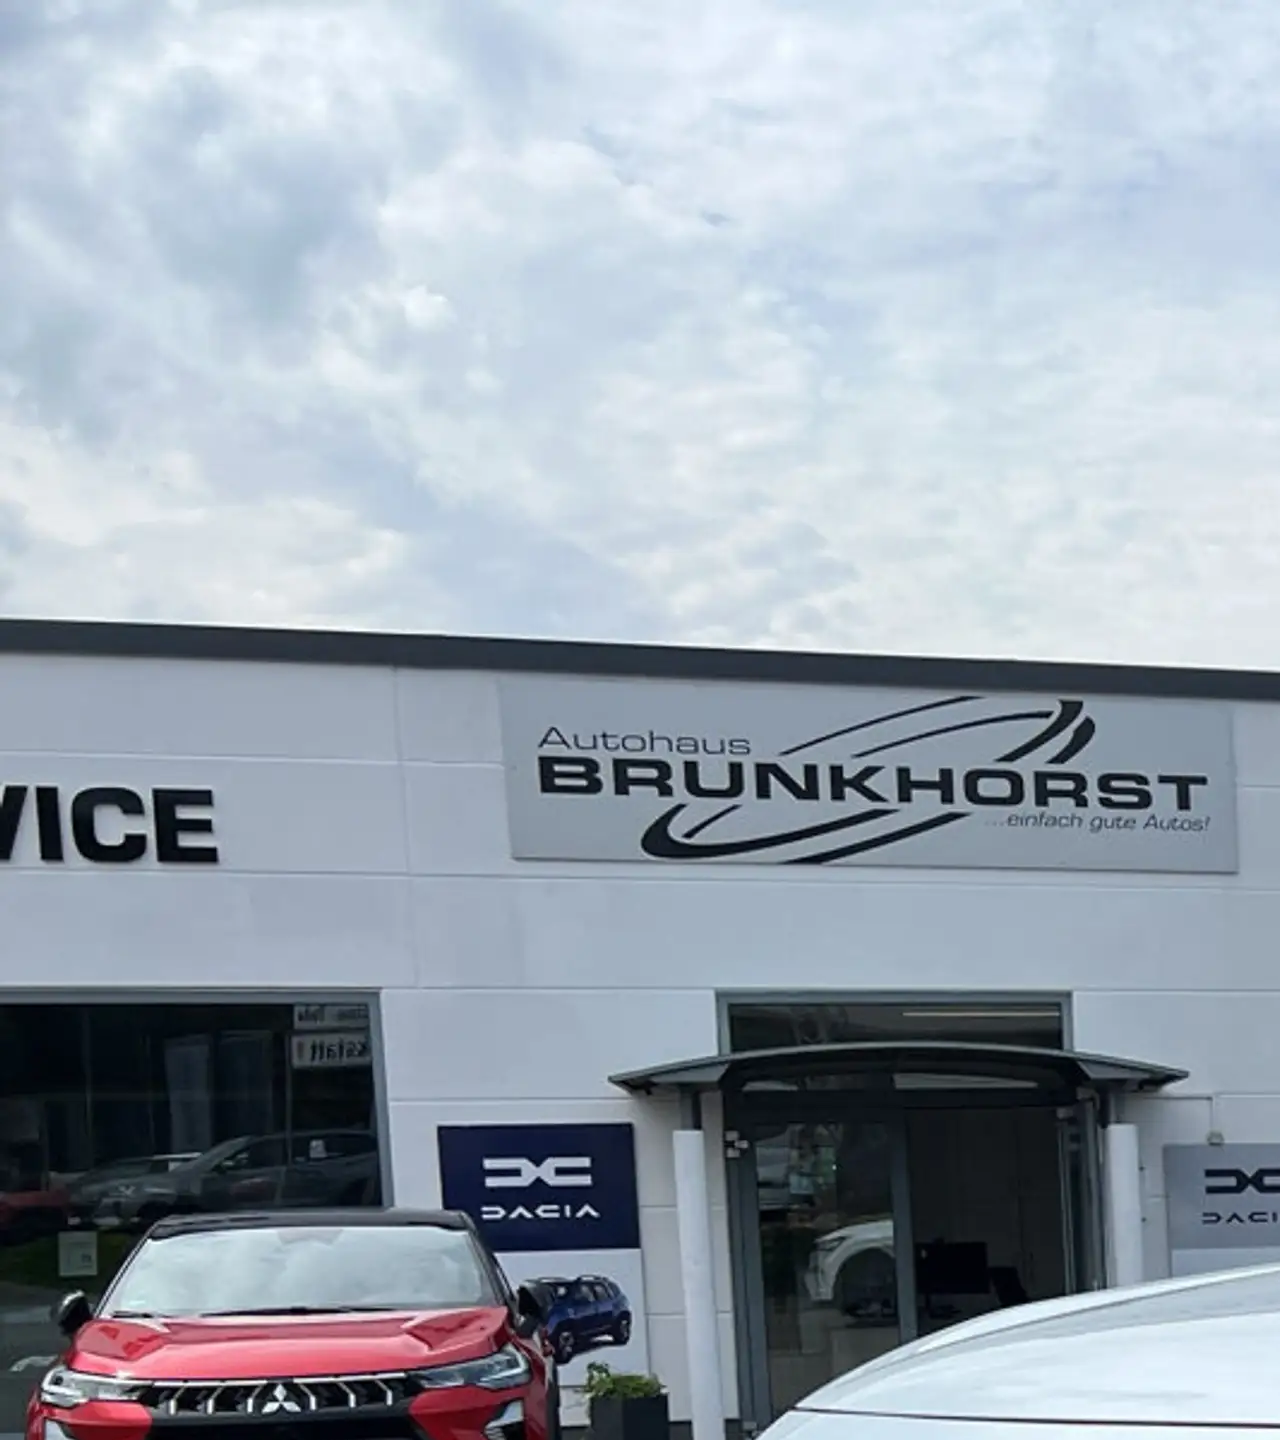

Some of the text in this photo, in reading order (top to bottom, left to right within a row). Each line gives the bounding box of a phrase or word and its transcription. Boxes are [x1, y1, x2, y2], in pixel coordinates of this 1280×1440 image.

[538, 727, 751, 756] Autohaus
[538, 755, 1208, 811] BRUNKHORST
[1089, 815, 1137, 833] gute
[1143, 814, 1211, 832] Autos!
[481, 1204, 600, 1219] DACIA
